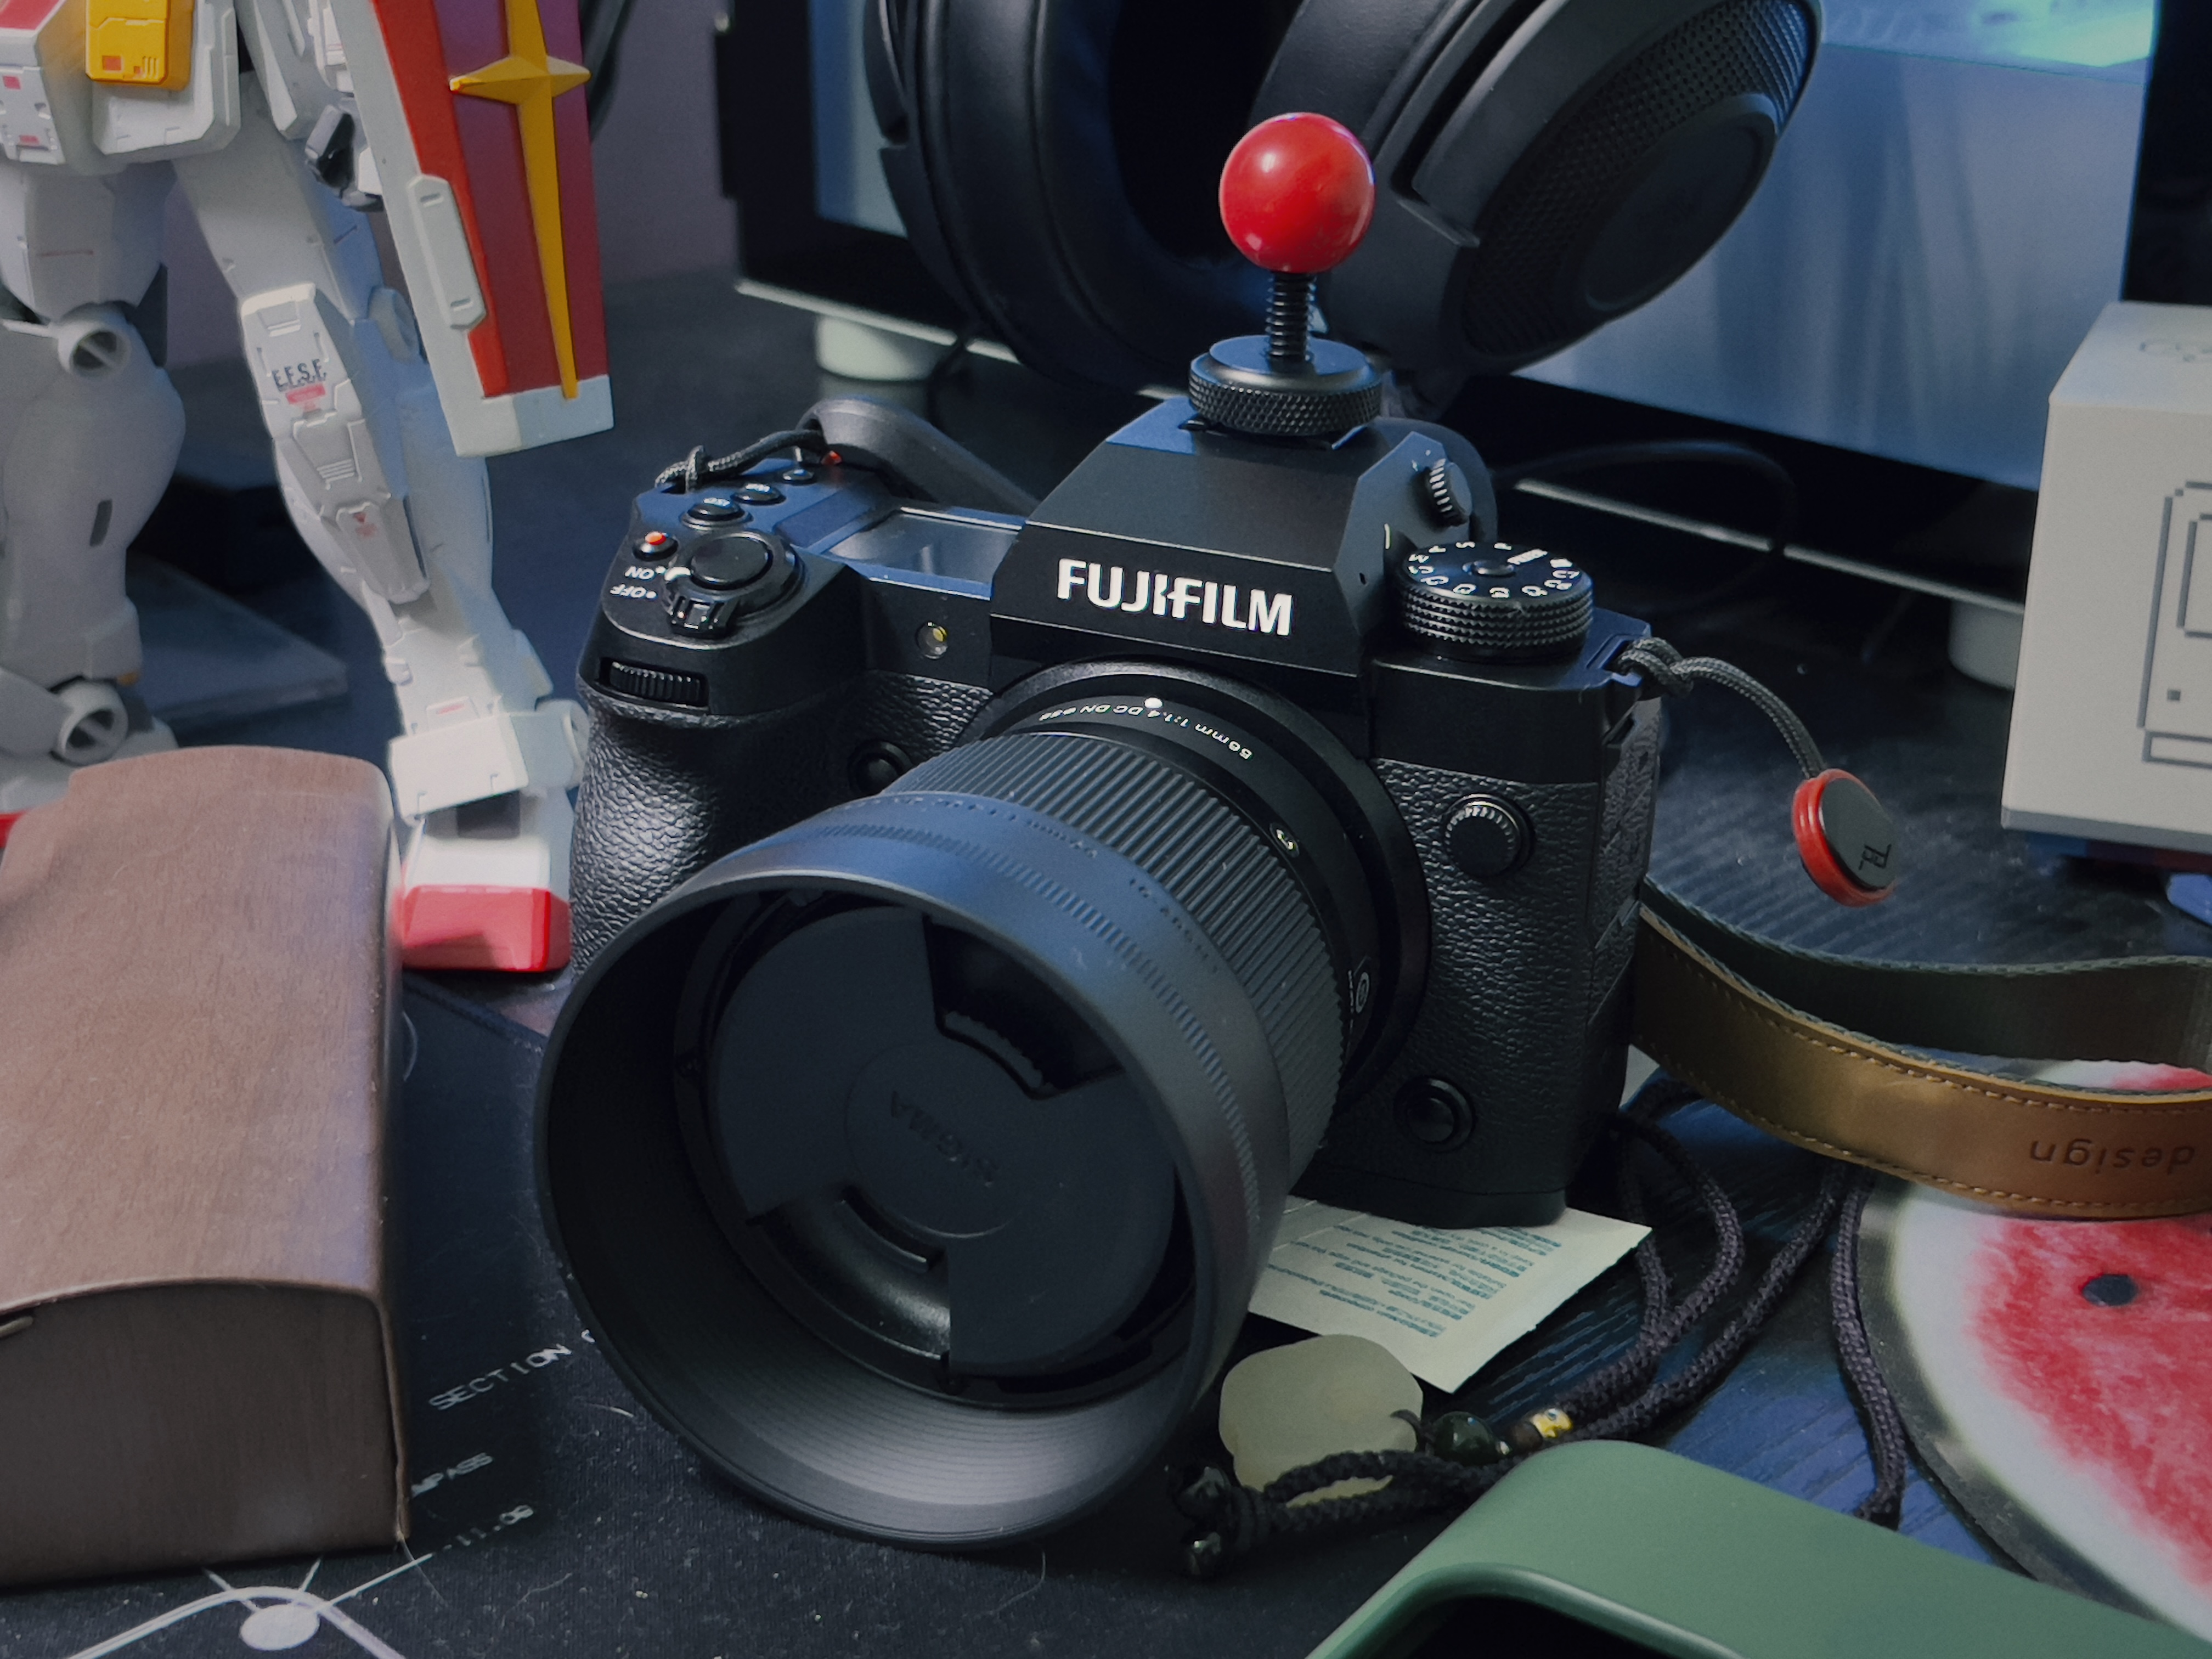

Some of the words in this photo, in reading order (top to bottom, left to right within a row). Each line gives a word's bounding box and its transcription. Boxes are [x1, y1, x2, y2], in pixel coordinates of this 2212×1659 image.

[625, 566, 654, 580] ON
[610, 584, 647, 599] OFF
[1057, 557, 1293, 637] FUJIFILM
[1079, 703, 1111, 714] DN
[1111, 704, 1144, 715] DC
[1147, 709, 1190, 729] 1:1.4
[1194, 723, 1254, 760] 56mm
[2030, 1139, 2195, 1175] design
[428, 1342, 572, 1411] SECTION
